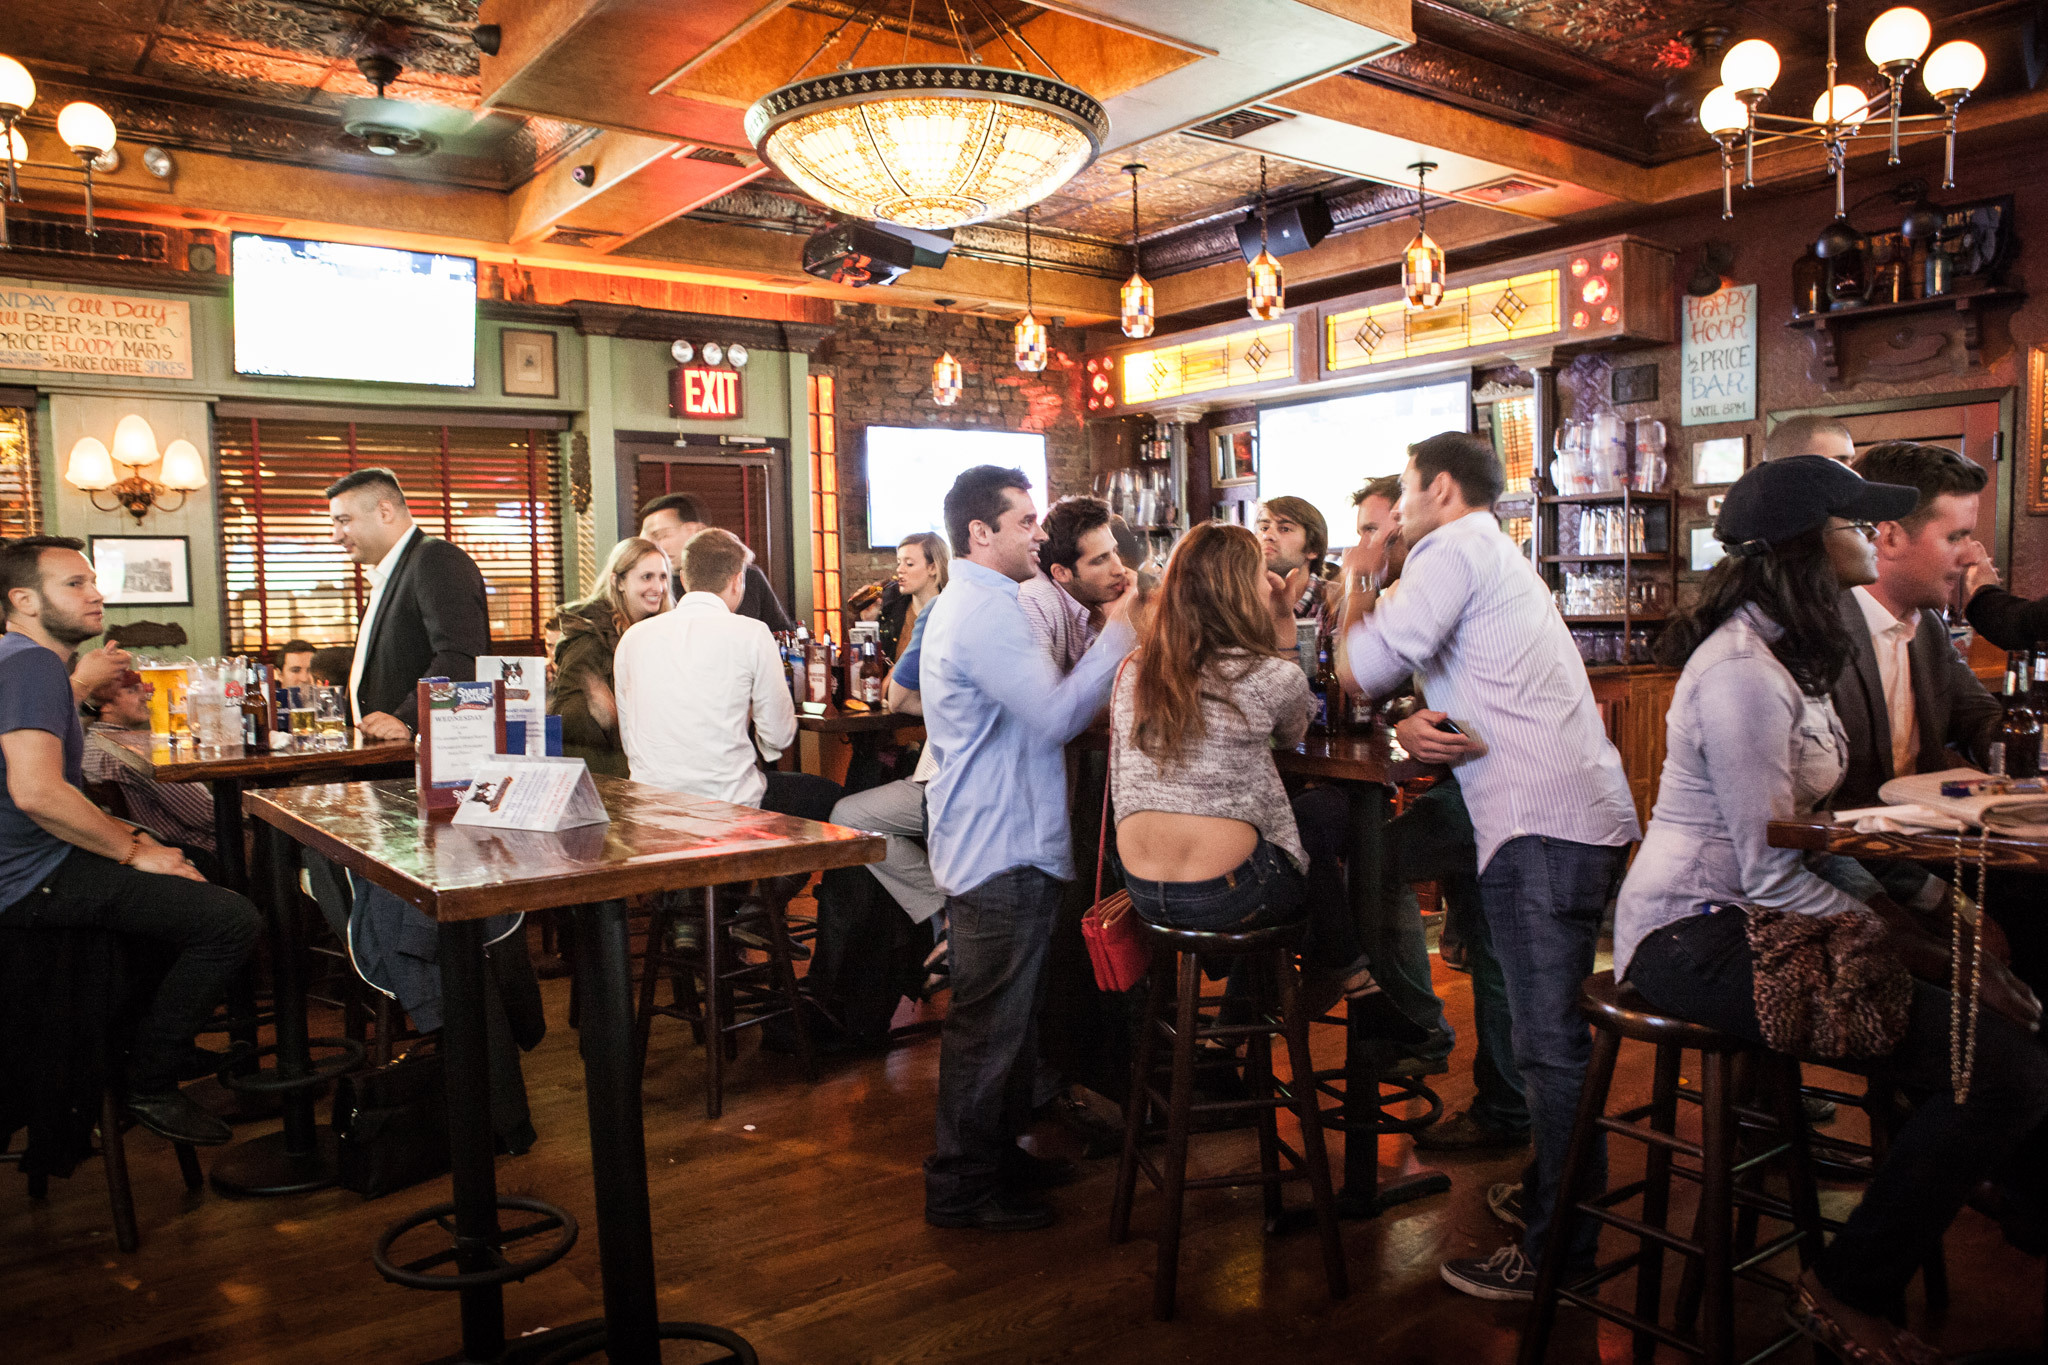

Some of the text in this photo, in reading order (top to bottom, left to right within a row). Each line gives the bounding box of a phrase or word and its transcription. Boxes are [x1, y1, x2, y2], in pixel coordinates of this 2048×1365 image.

[24, 312, 82, 335] BEER
[105, 320, 156, 340] PRICE
[52, 335, 119, 357] BLOODY
[123, 340, 173, 360] MARYS
[1701, 345, 1750, 371] PRICE
[63, 354, 99, 371] PRICE
[101, 357, 143, 373] COFFEE
[684, 369, 738, 415] EXIT
[1690, 404, 1719, 418] UNTIL
